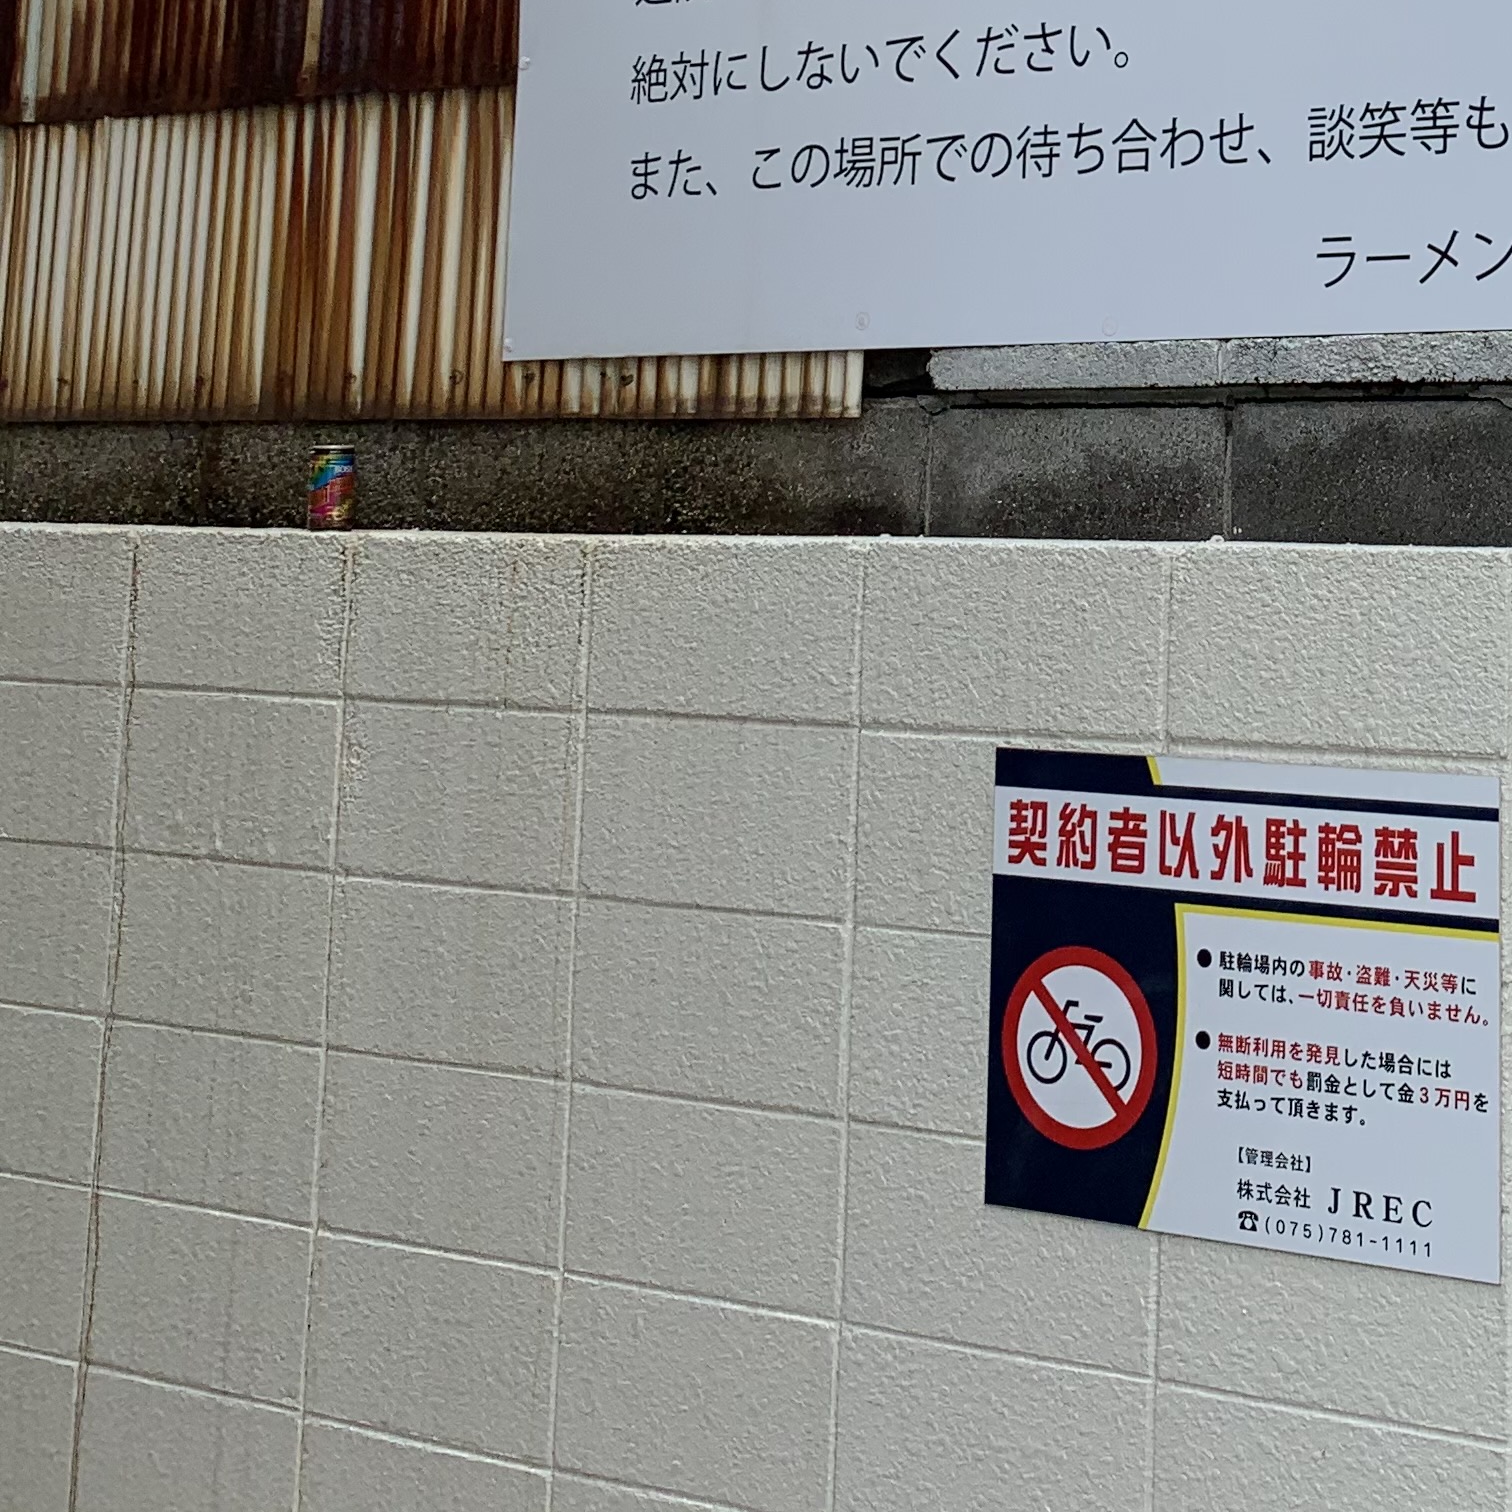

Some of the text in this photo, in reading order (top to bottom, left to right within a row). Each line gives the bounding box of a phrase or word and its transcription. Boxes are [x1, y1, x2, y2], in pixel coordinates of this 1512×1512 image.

[629, 21, 1130, 106] 絶対にしないでください。
[1007, 798, 1477, 903] 契約者以外駐輪禁止
[1218, 978, 1489, 1027] 関しては、一切責任を負いません。
[1217, 1032, 1452, 1079] 無断利用を発見した場合には
[1216, 1088, 1366, 1126] 支払って頂きます。
[1236, 1178, 1433, 1228] 株式会社 JREC
[1264, 1216, 1432, 1258] (075)781-1111
